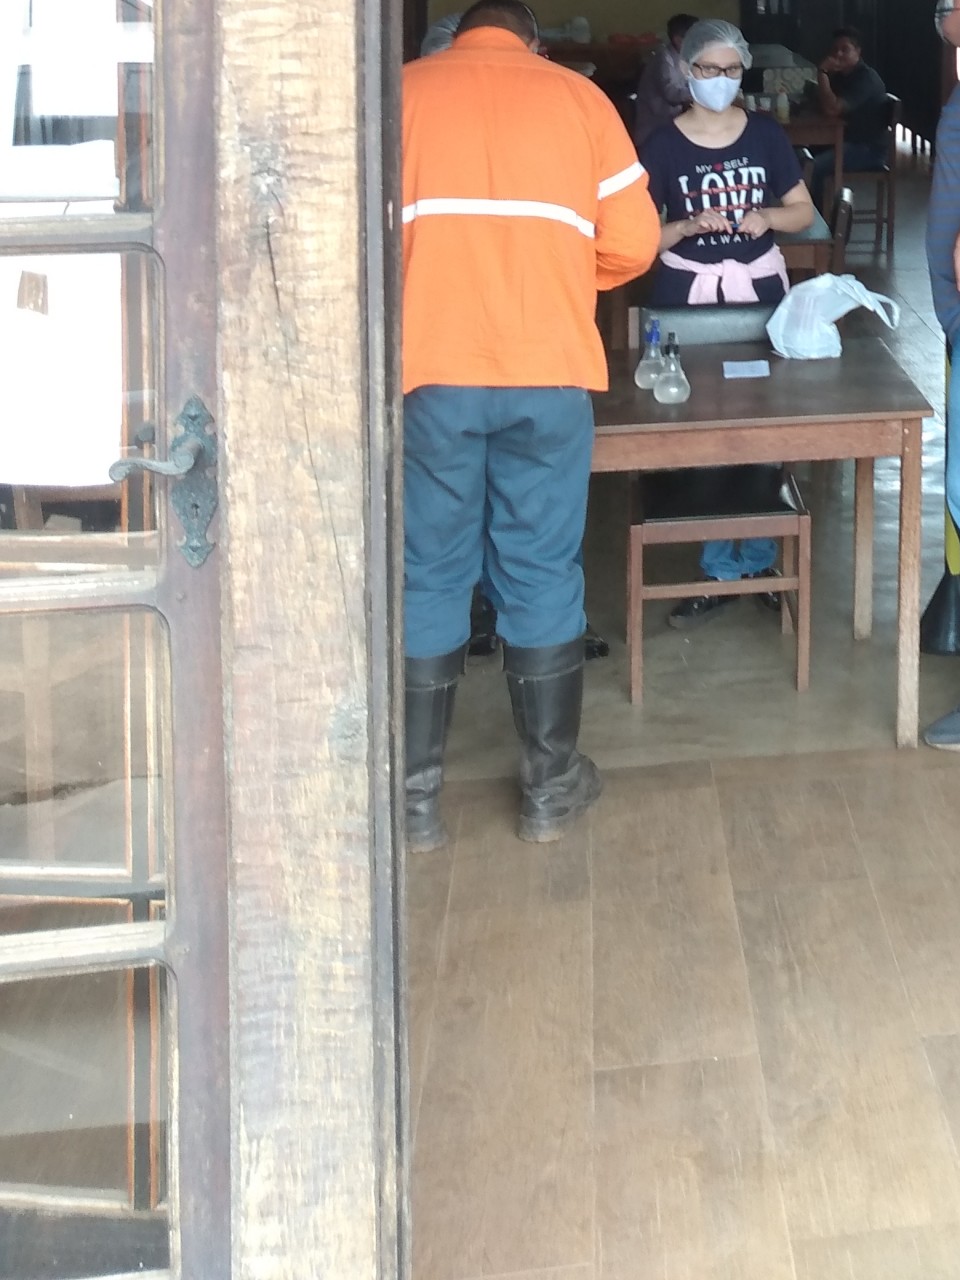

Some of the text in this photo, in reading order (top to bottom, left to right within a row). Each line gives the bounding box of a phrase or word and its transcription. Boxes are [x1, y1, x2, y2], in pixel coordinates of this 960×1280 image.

[695, 156, 749, 174] MY SELF
[678, 166, 767, 224] LOVE
[696, 233, 750, 247] ALWA
